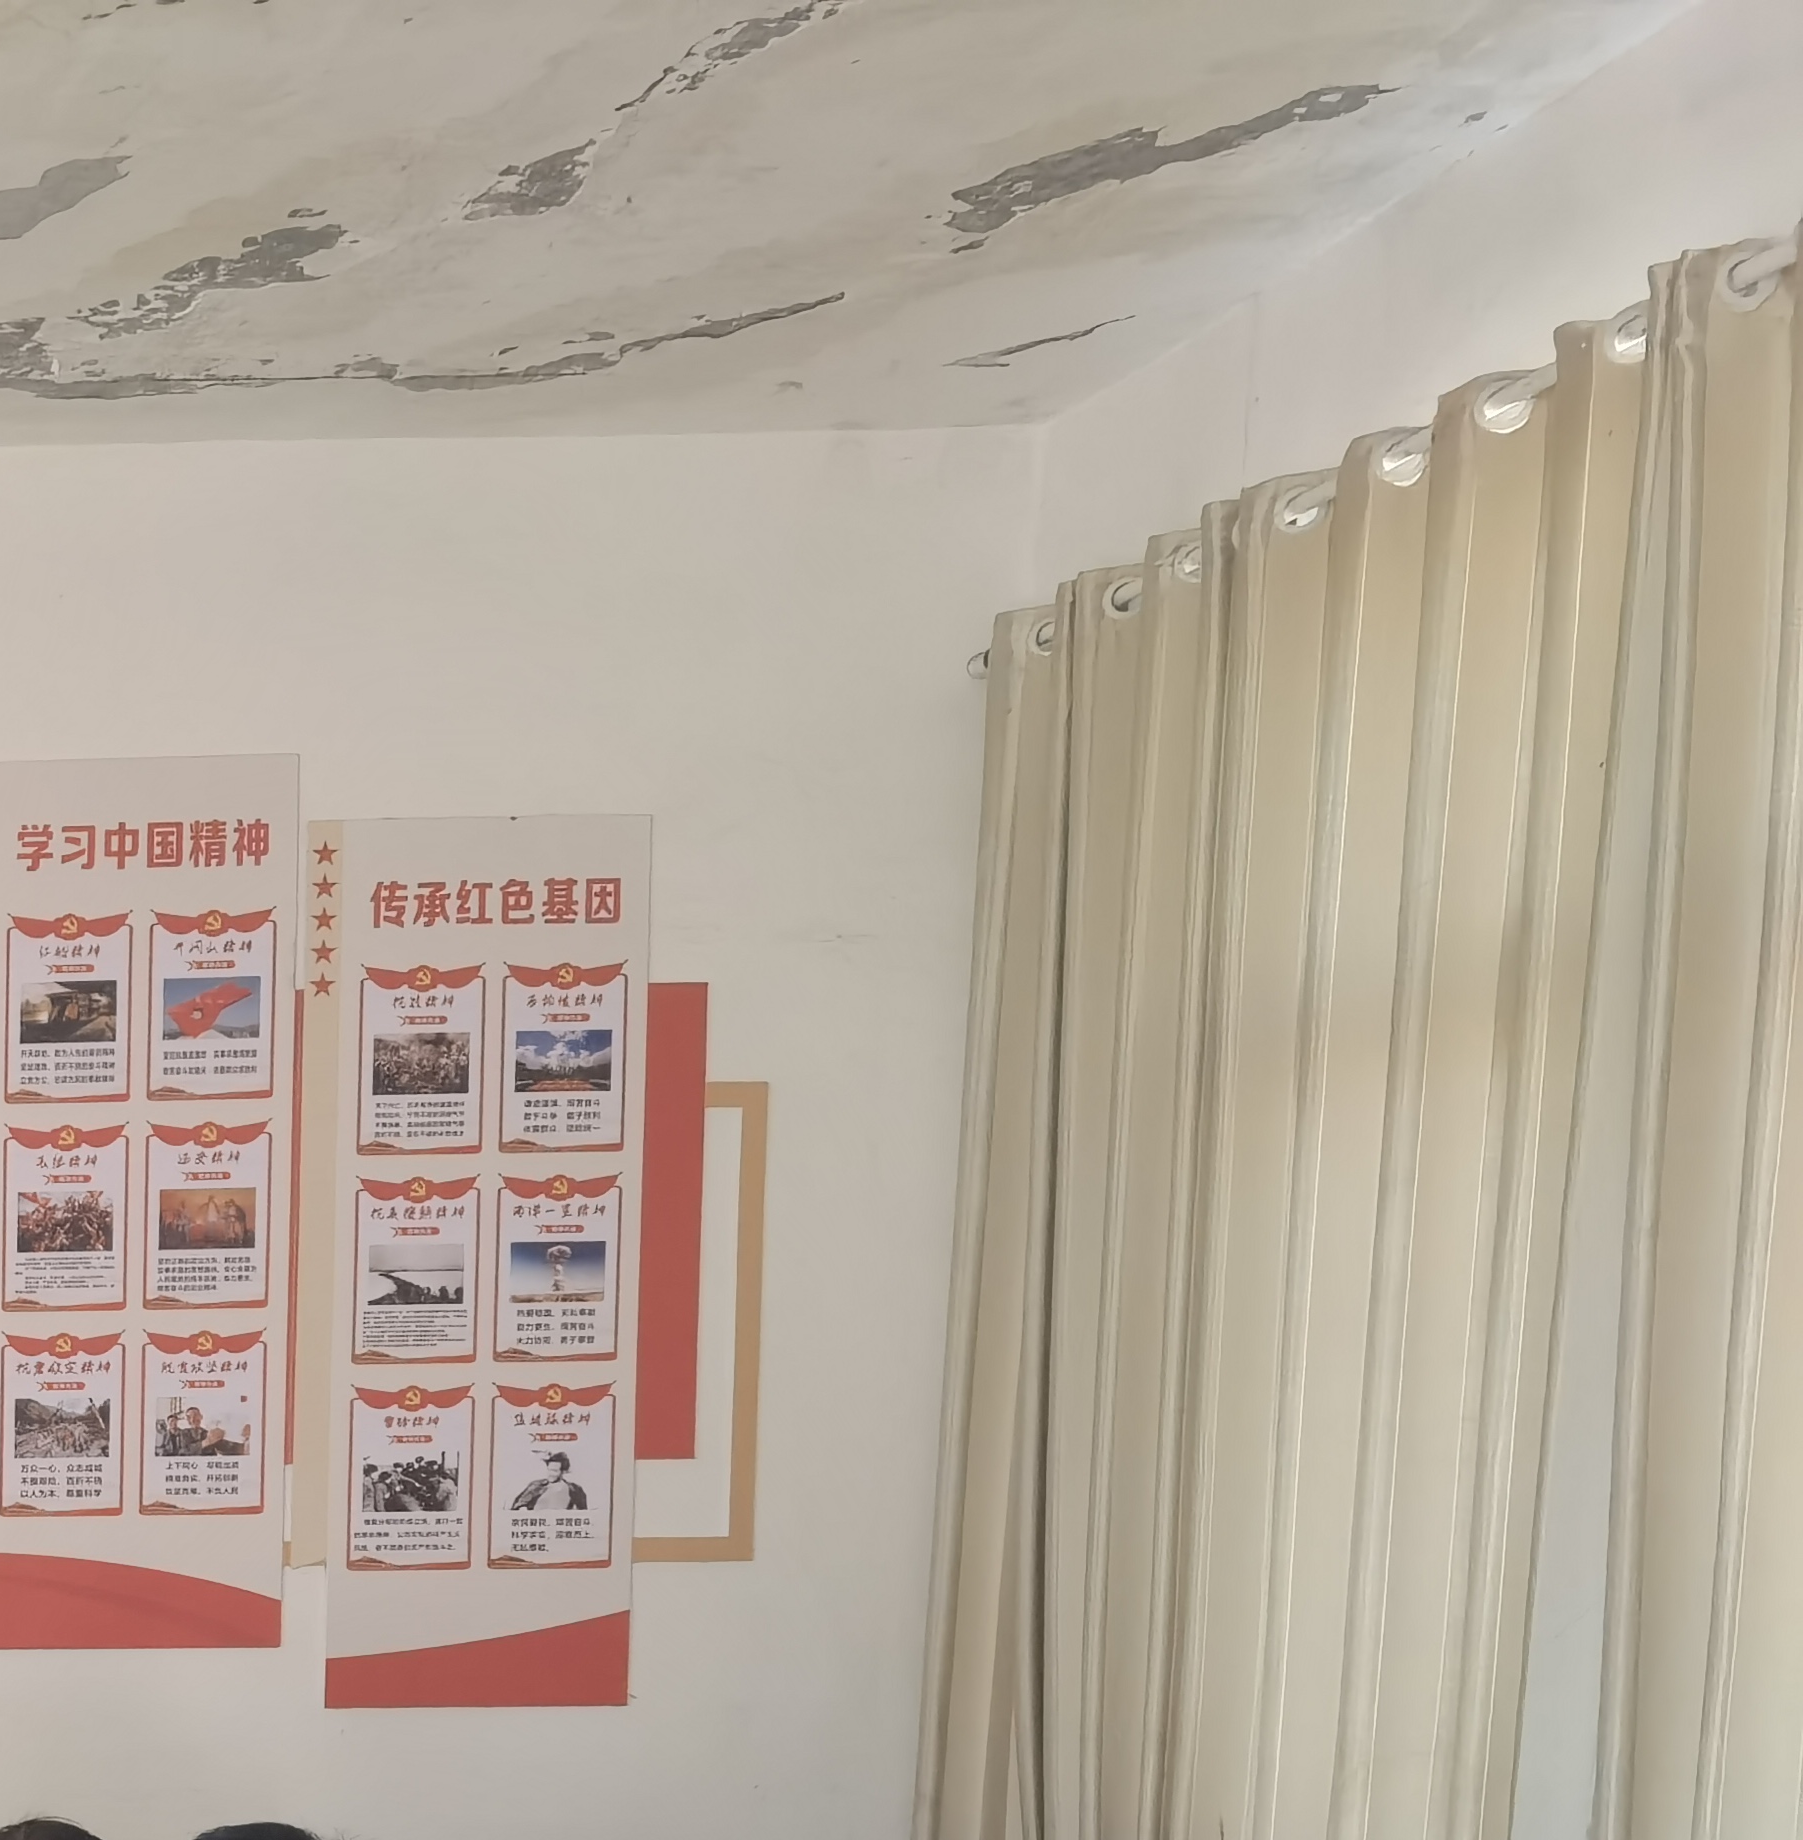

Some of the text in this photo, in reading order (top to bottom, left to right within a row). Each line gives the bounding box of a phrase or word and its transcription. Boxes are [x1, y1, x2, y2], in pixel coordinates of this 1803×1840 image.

[17, 820, 270, 871] 学习中国精神
[371, 877, 621, 928] 传承红色基因
